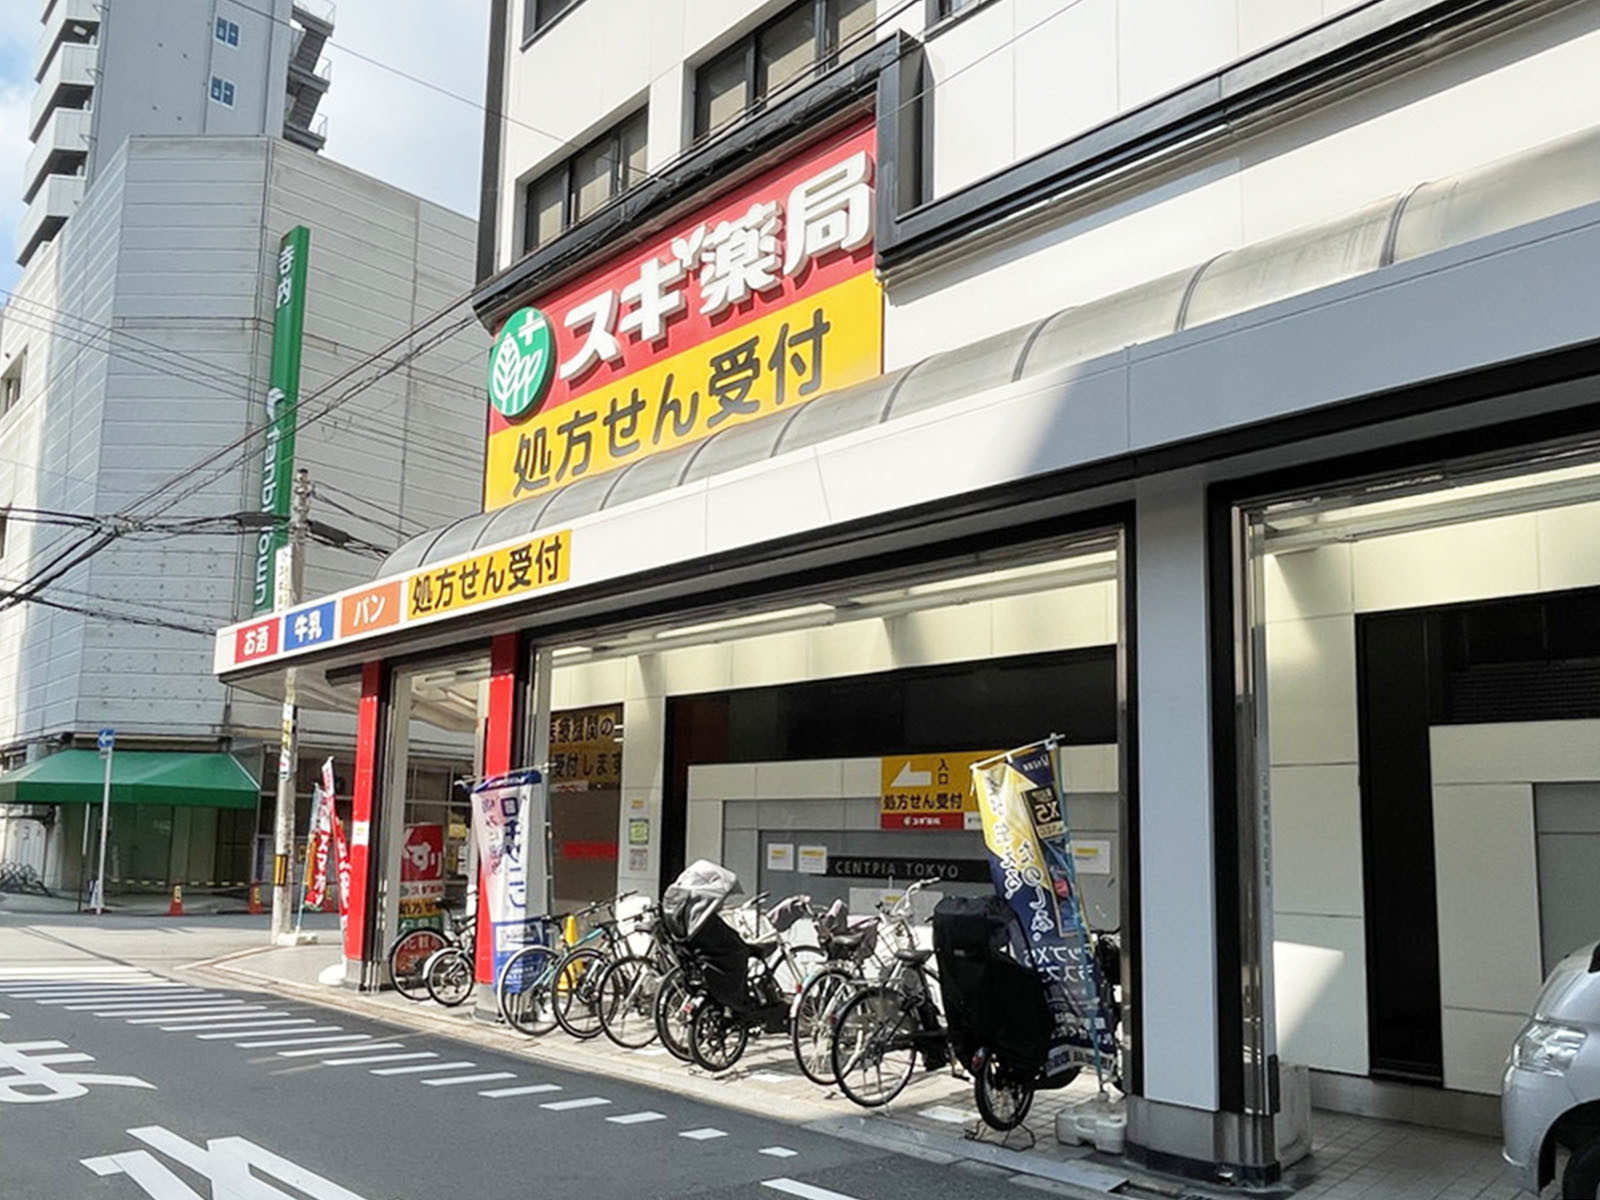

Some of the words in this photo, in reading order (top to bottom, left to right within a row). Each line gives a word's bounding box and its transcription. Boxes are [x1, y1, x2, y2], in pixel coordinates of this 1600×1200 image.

[559, 151, 874, 383] スギ薬局
[512, 307, 831, 498] 処方せん受付
[411, 540, 563, 616] 処方せん受付
[353, 594, 386, 628] パン
[242, 625, 268, 657] お酒
[293, 612, 323, 644] 牛乳
[938, 758, 949, 785] 入口
[883, 792, 964, 811] 処方せん受付
[905, 861, 960, 879] TOKYO
